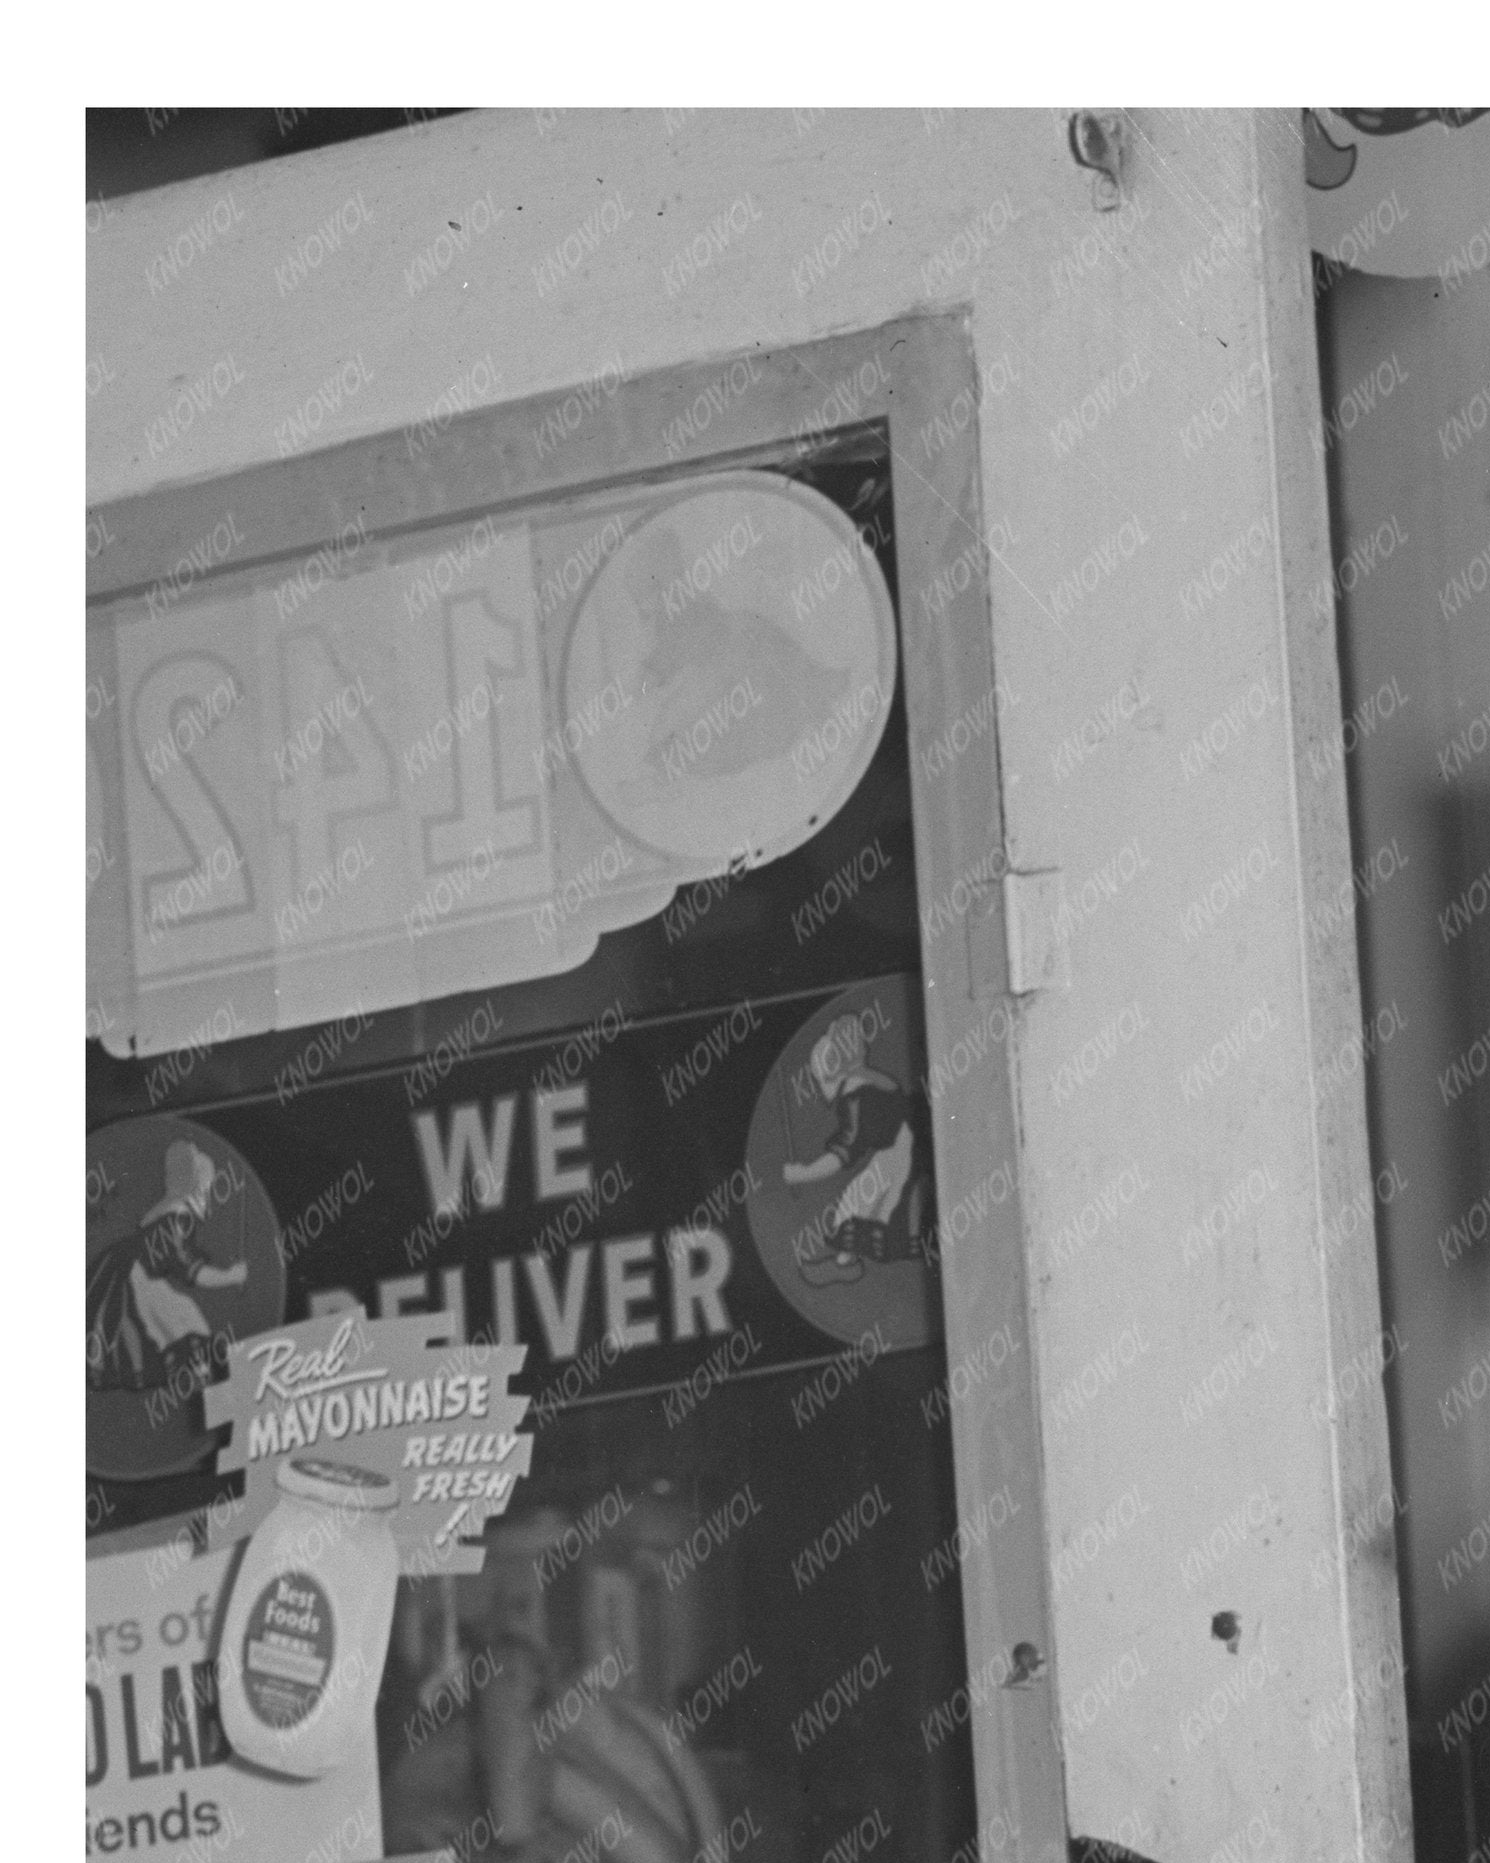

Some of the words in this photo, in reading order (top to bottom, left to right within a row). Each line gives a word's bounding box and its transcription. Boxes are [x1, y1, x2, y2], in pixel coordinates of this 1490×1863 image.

[411, 1082, 594, 1215] WE
[248, 1317, 355, 1400] Real
[248, 1374, 489, 1461] MAYONNAISE
[401, 1432, 519, 1468] REALLY
[86, 1620, 144, 1661] rs
[265, 1599, 321, 1634] Foods
